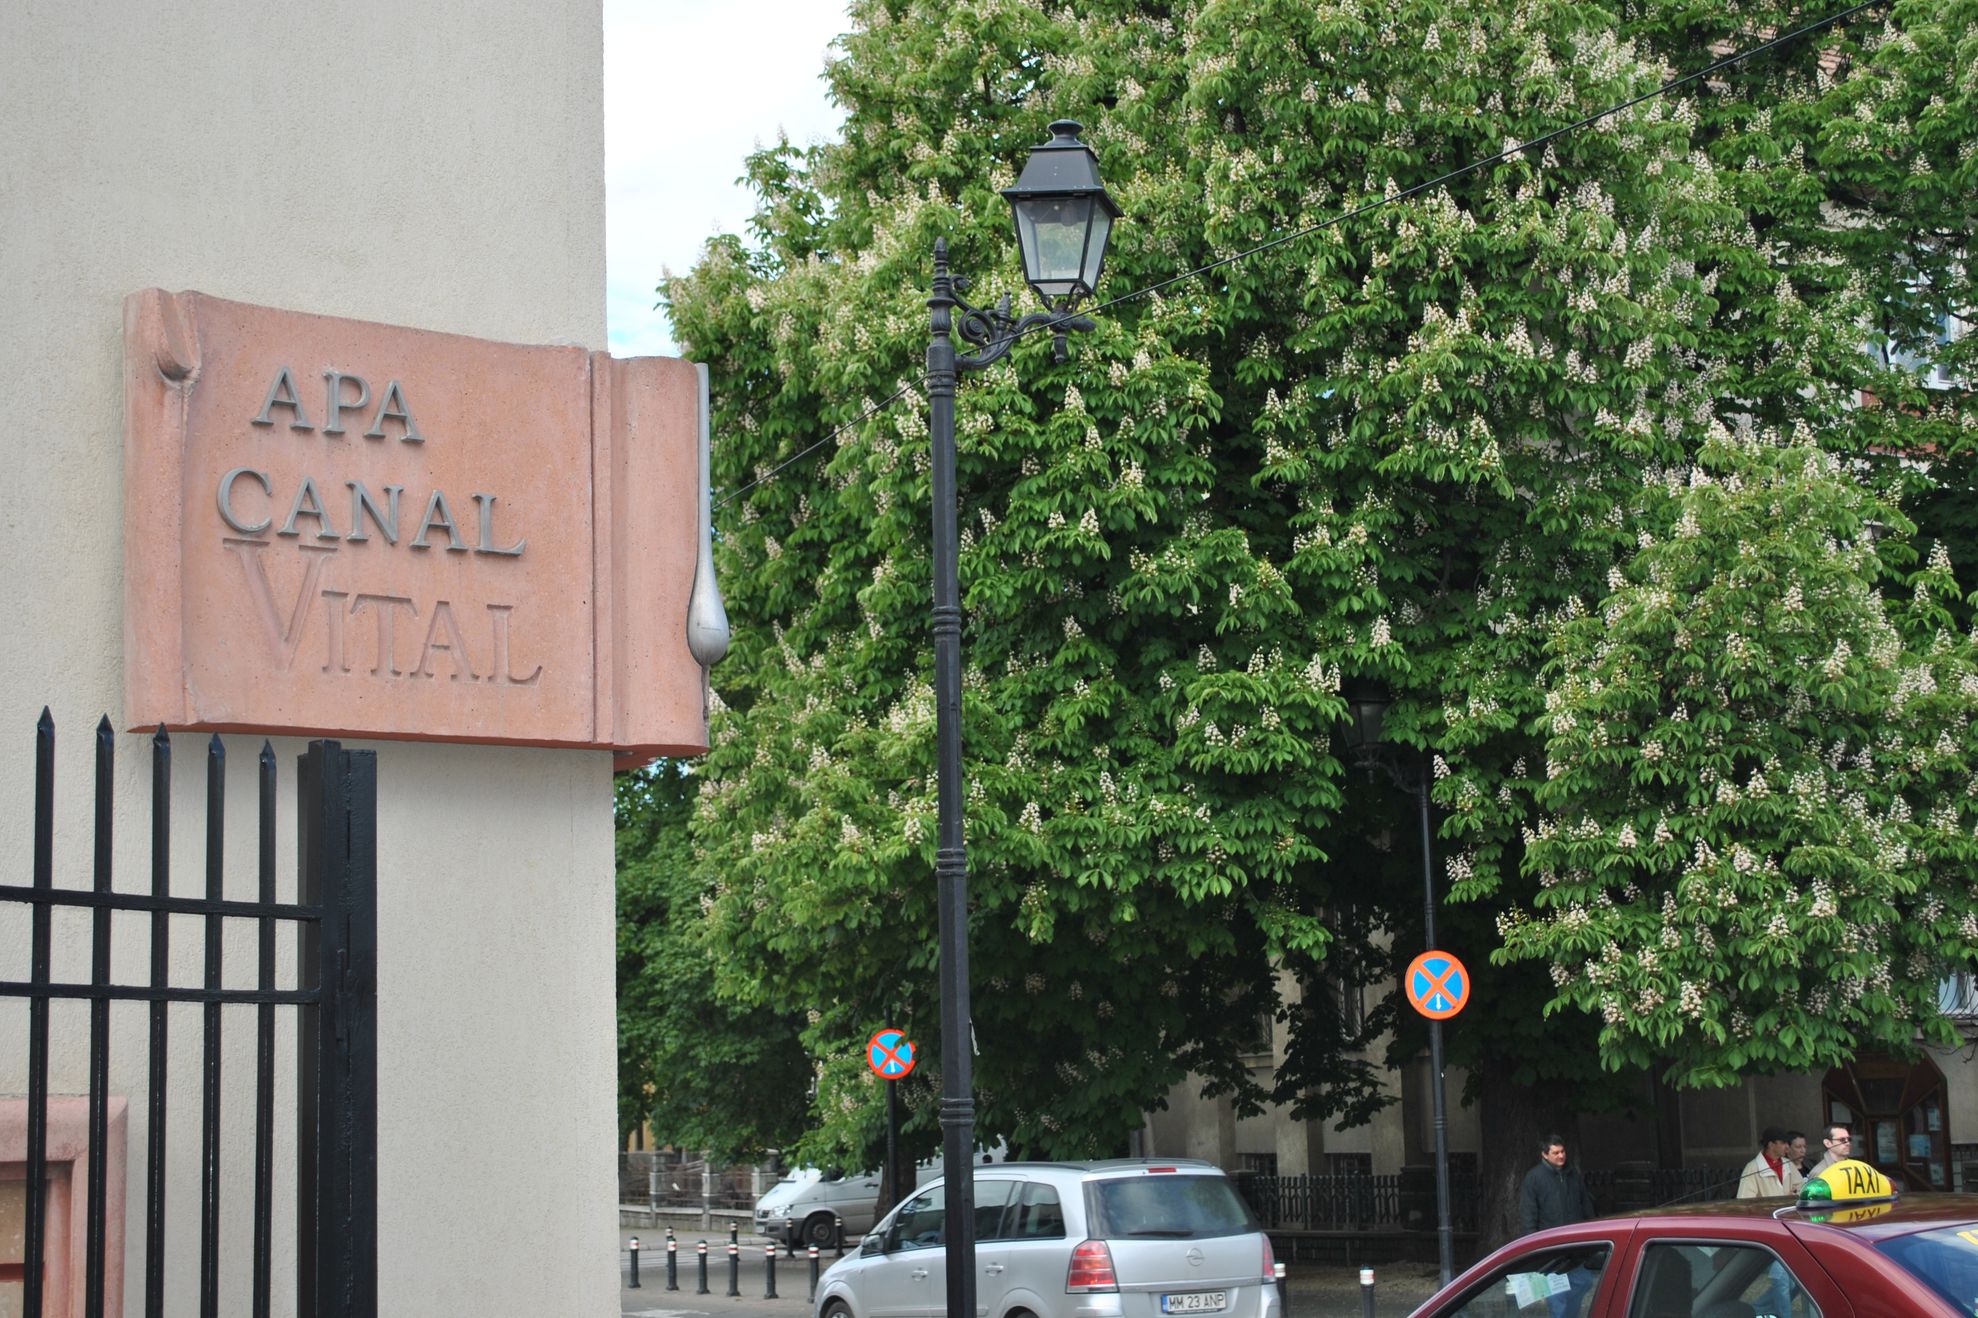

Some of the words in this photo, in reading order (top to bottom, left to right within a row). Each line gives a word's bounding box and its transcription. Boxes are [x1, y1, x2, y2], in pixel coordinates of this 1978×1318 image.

[251, 365, 425, 445] APA
[217, 467, 527, 557] CANAL
[222, 536, 543, 687] VITAL
[1839, 1165, 1880, 1195] TAXI
[1168, 1296, 1184, 1310] MM
[1187, 1295, 1200, 1309] 23
[1203, 1293, 1224, 1308] ANP
